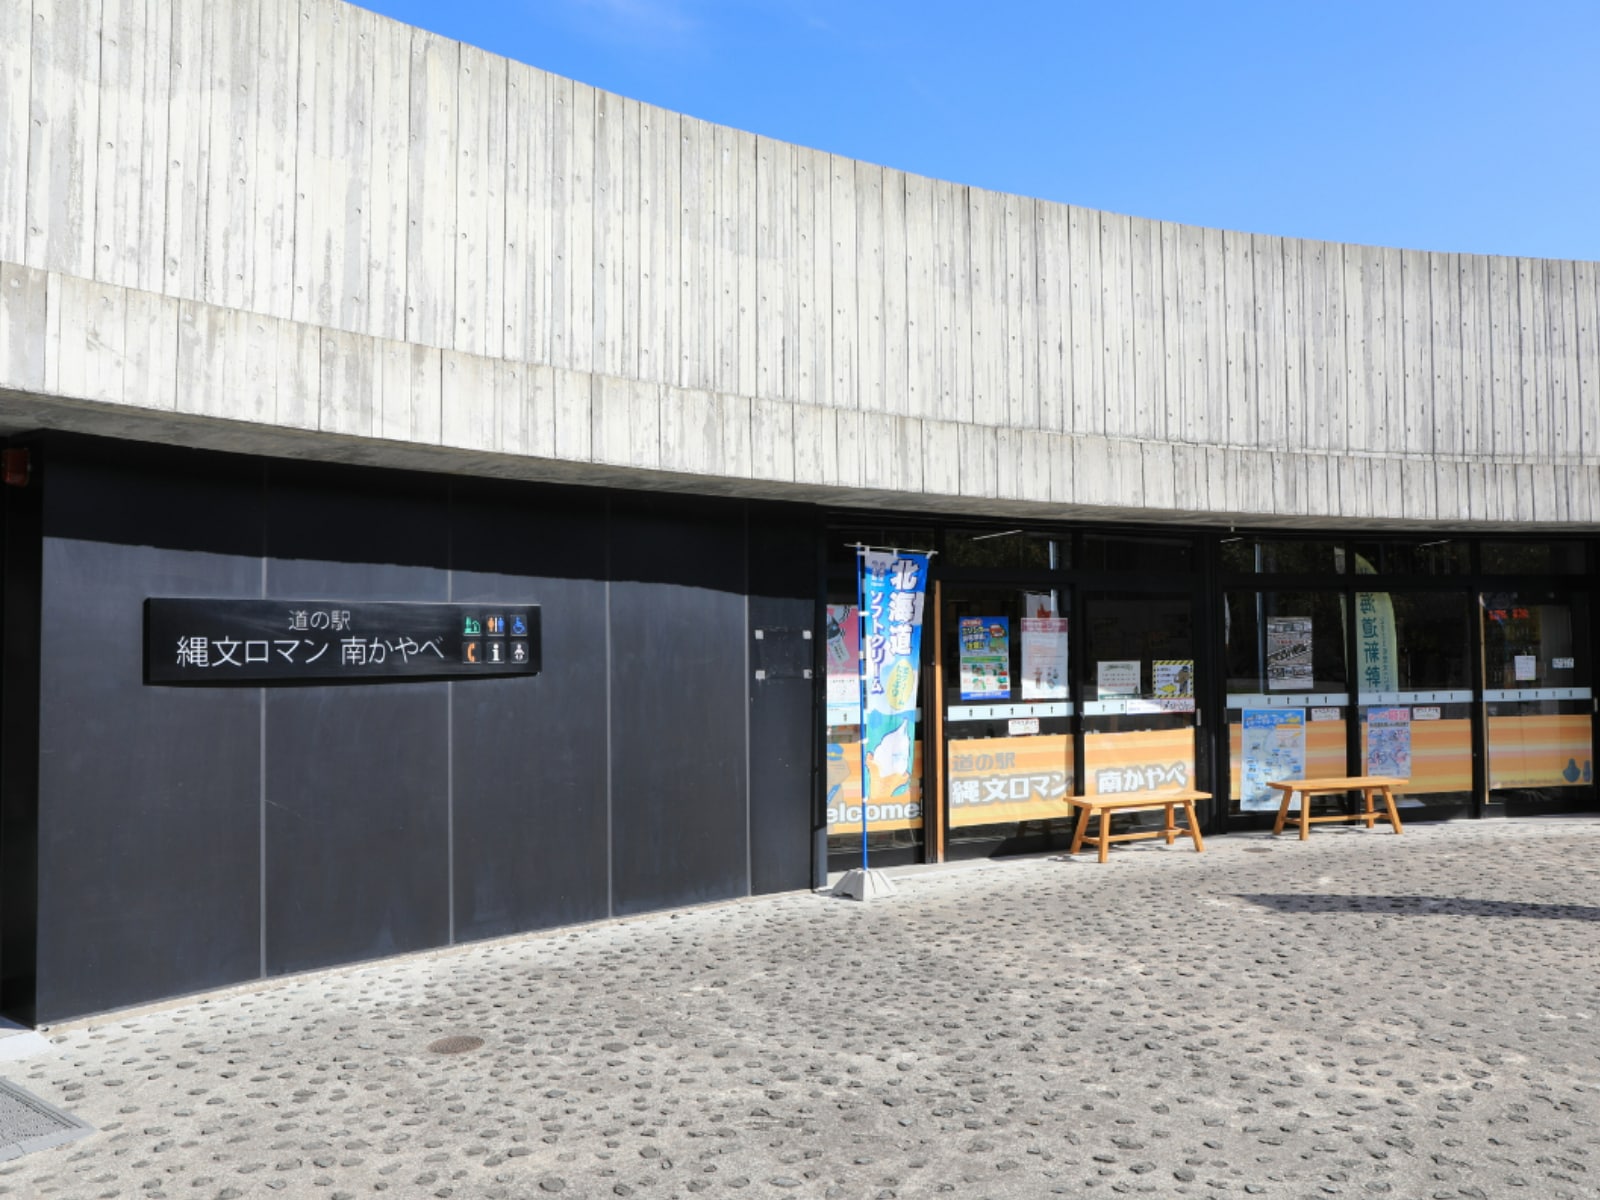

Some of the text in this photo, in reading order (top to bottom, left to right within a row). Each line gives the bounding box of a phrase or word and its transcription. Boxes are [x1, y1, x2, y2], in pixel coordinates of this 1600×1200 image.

[288, 609, 351, 631] 道の駅
[888, 559, 919, 656] 北海道
[176, 635, 445, 668] 縄文ロマン 南かやべ
[869, 590, 885, 695] ソフトクリーム
[952, 752, 1016, 772] 道の駅
[1097, 762, 1187, 794] 南かやべ
[951, 773, 1072, 805] 縄文ロマン
